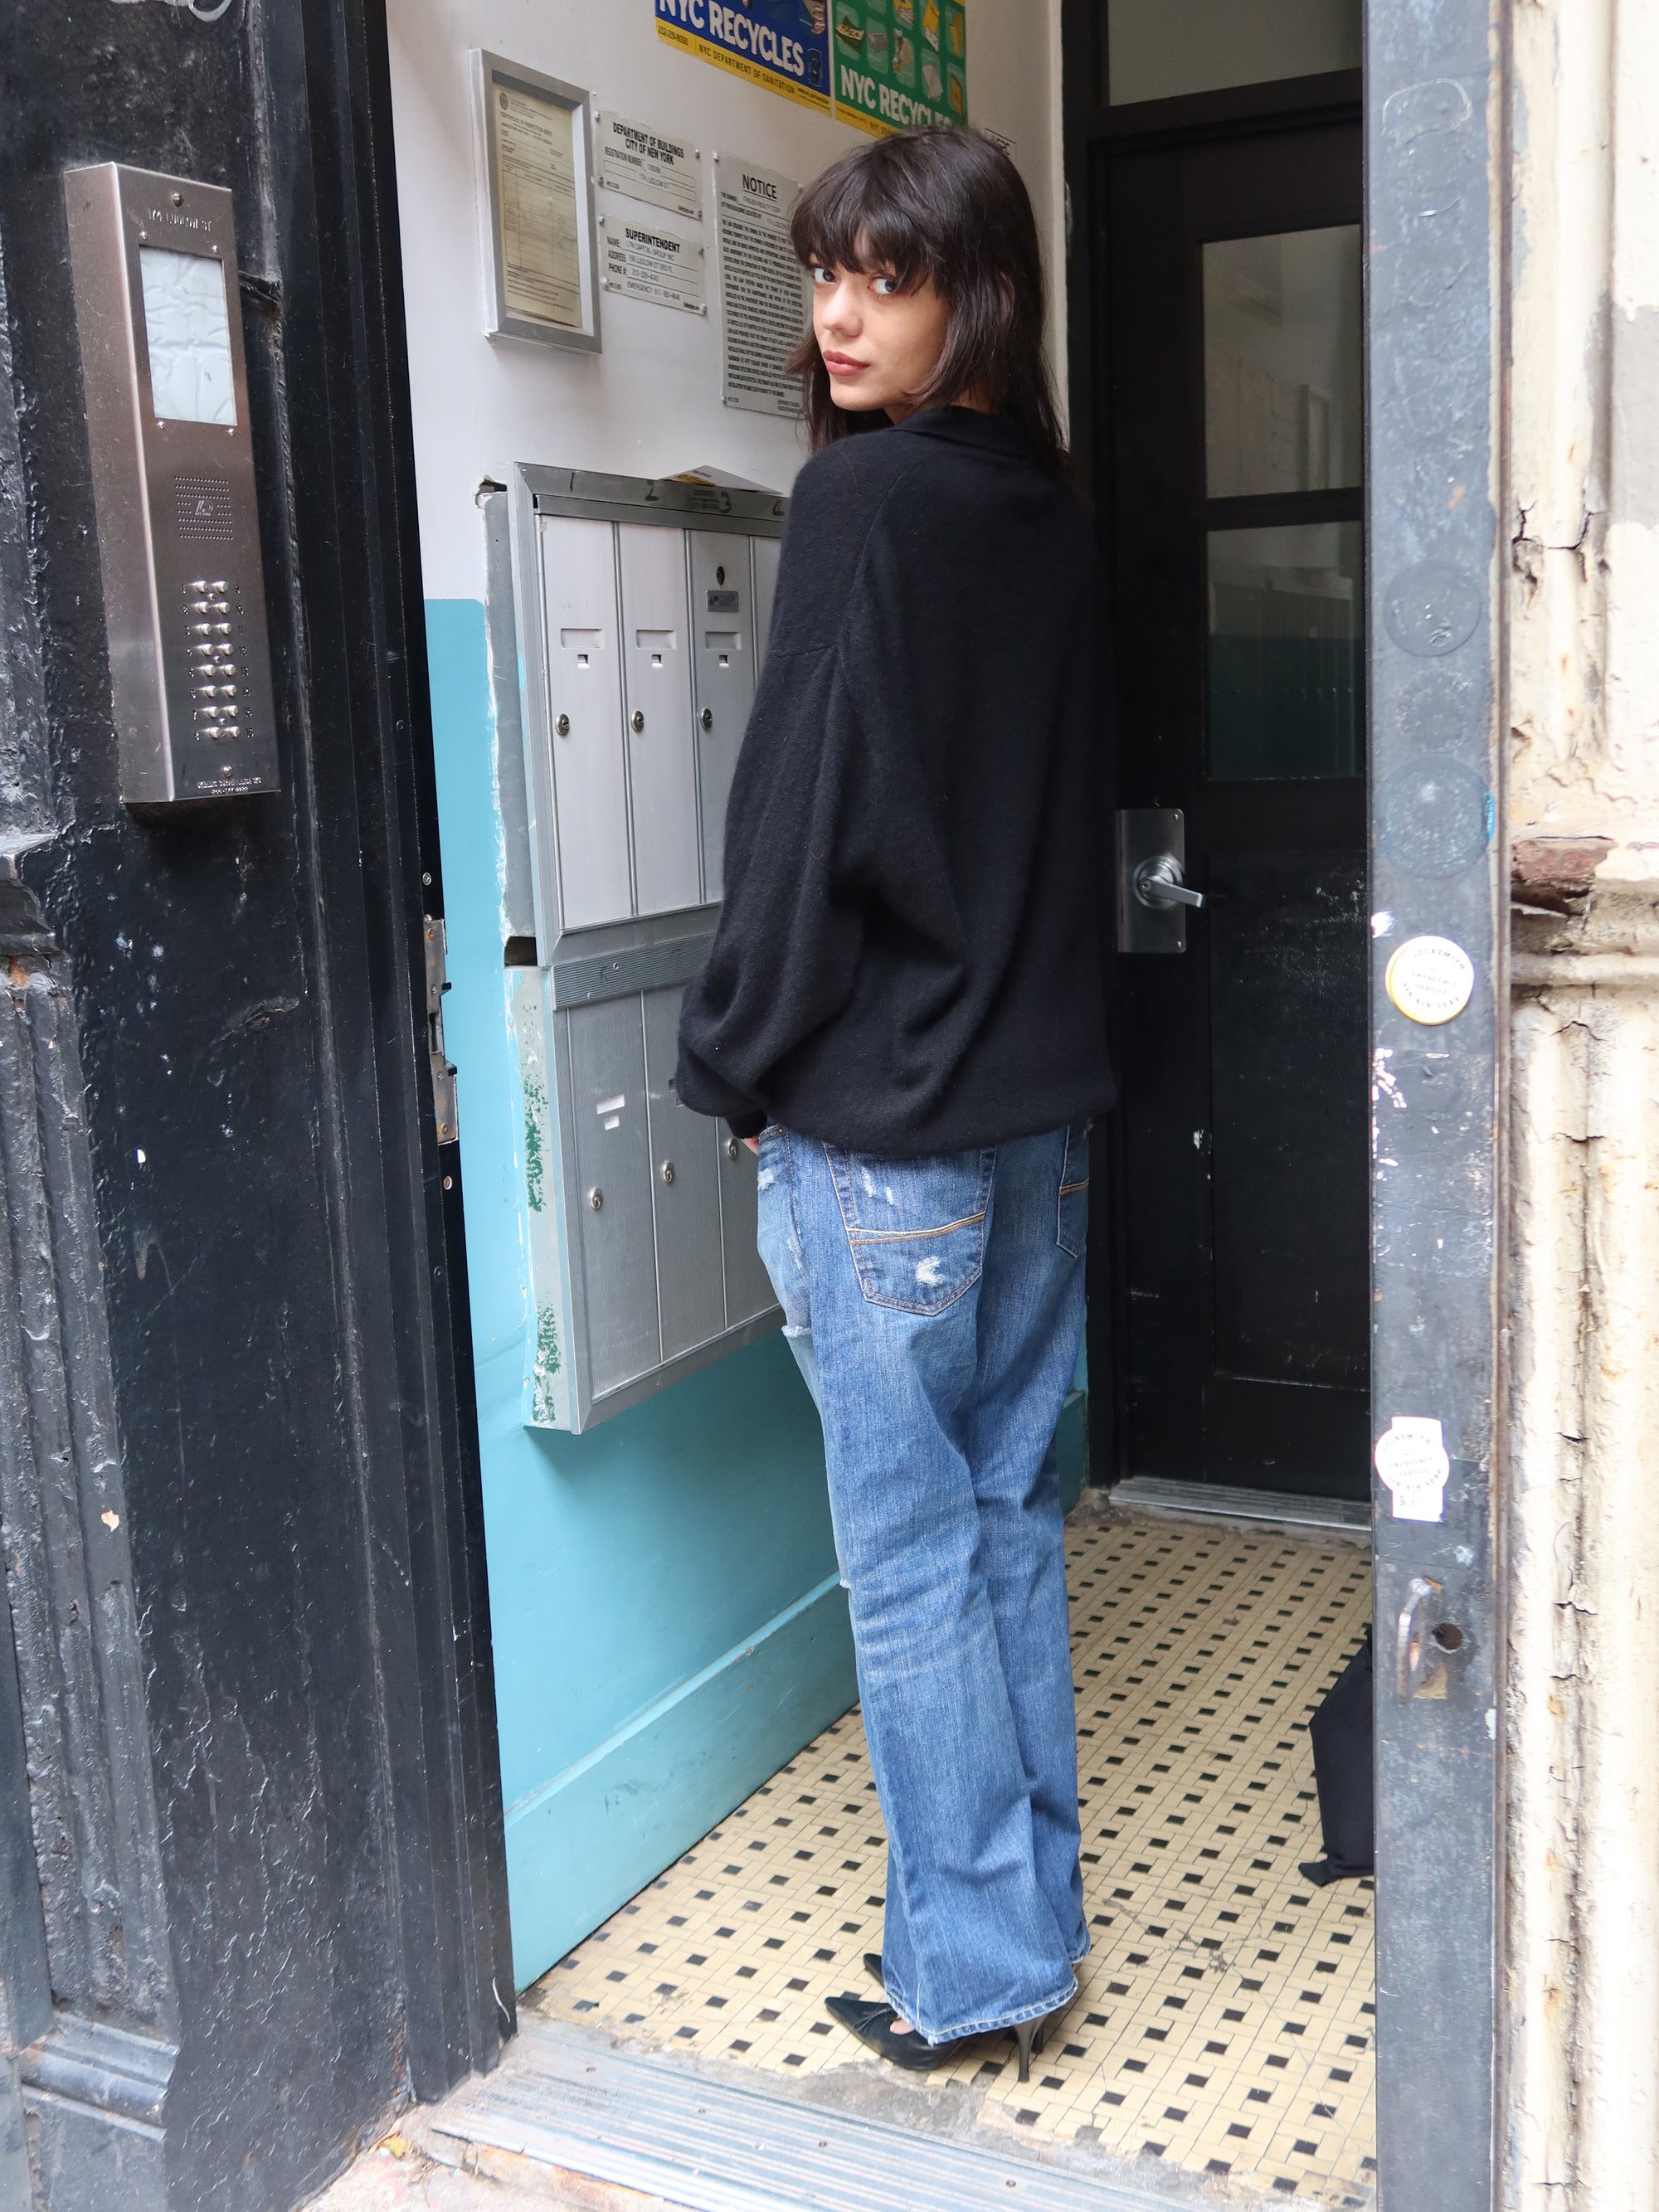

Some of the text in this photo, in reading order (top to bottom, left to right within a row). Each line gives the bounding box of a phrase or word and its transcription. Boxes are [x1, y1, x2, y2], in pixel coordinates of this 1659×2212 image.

[708, 1, 805, 76] RECYCLES
[698, 44, 795, 92] NYC DEPARTMENT OF SANITATION
[840, 65, 876, 109] NYC
[613, 122, 684, 158] DEPARTMENT OF BUILDINGS
[625, 139, 674, 165] CITY OF NEW YORK
[742, 174, 777, 199] NOTICE
[625, 228, 680, 253] SUPERINTENDENT
[608, 263, 622, 274] PHONE
[570, 471, 575, 492] 1
[645, 479, 659, 501] 2
[719, 491, 732, 513] 3
[772, 499, 786, 516] 4
